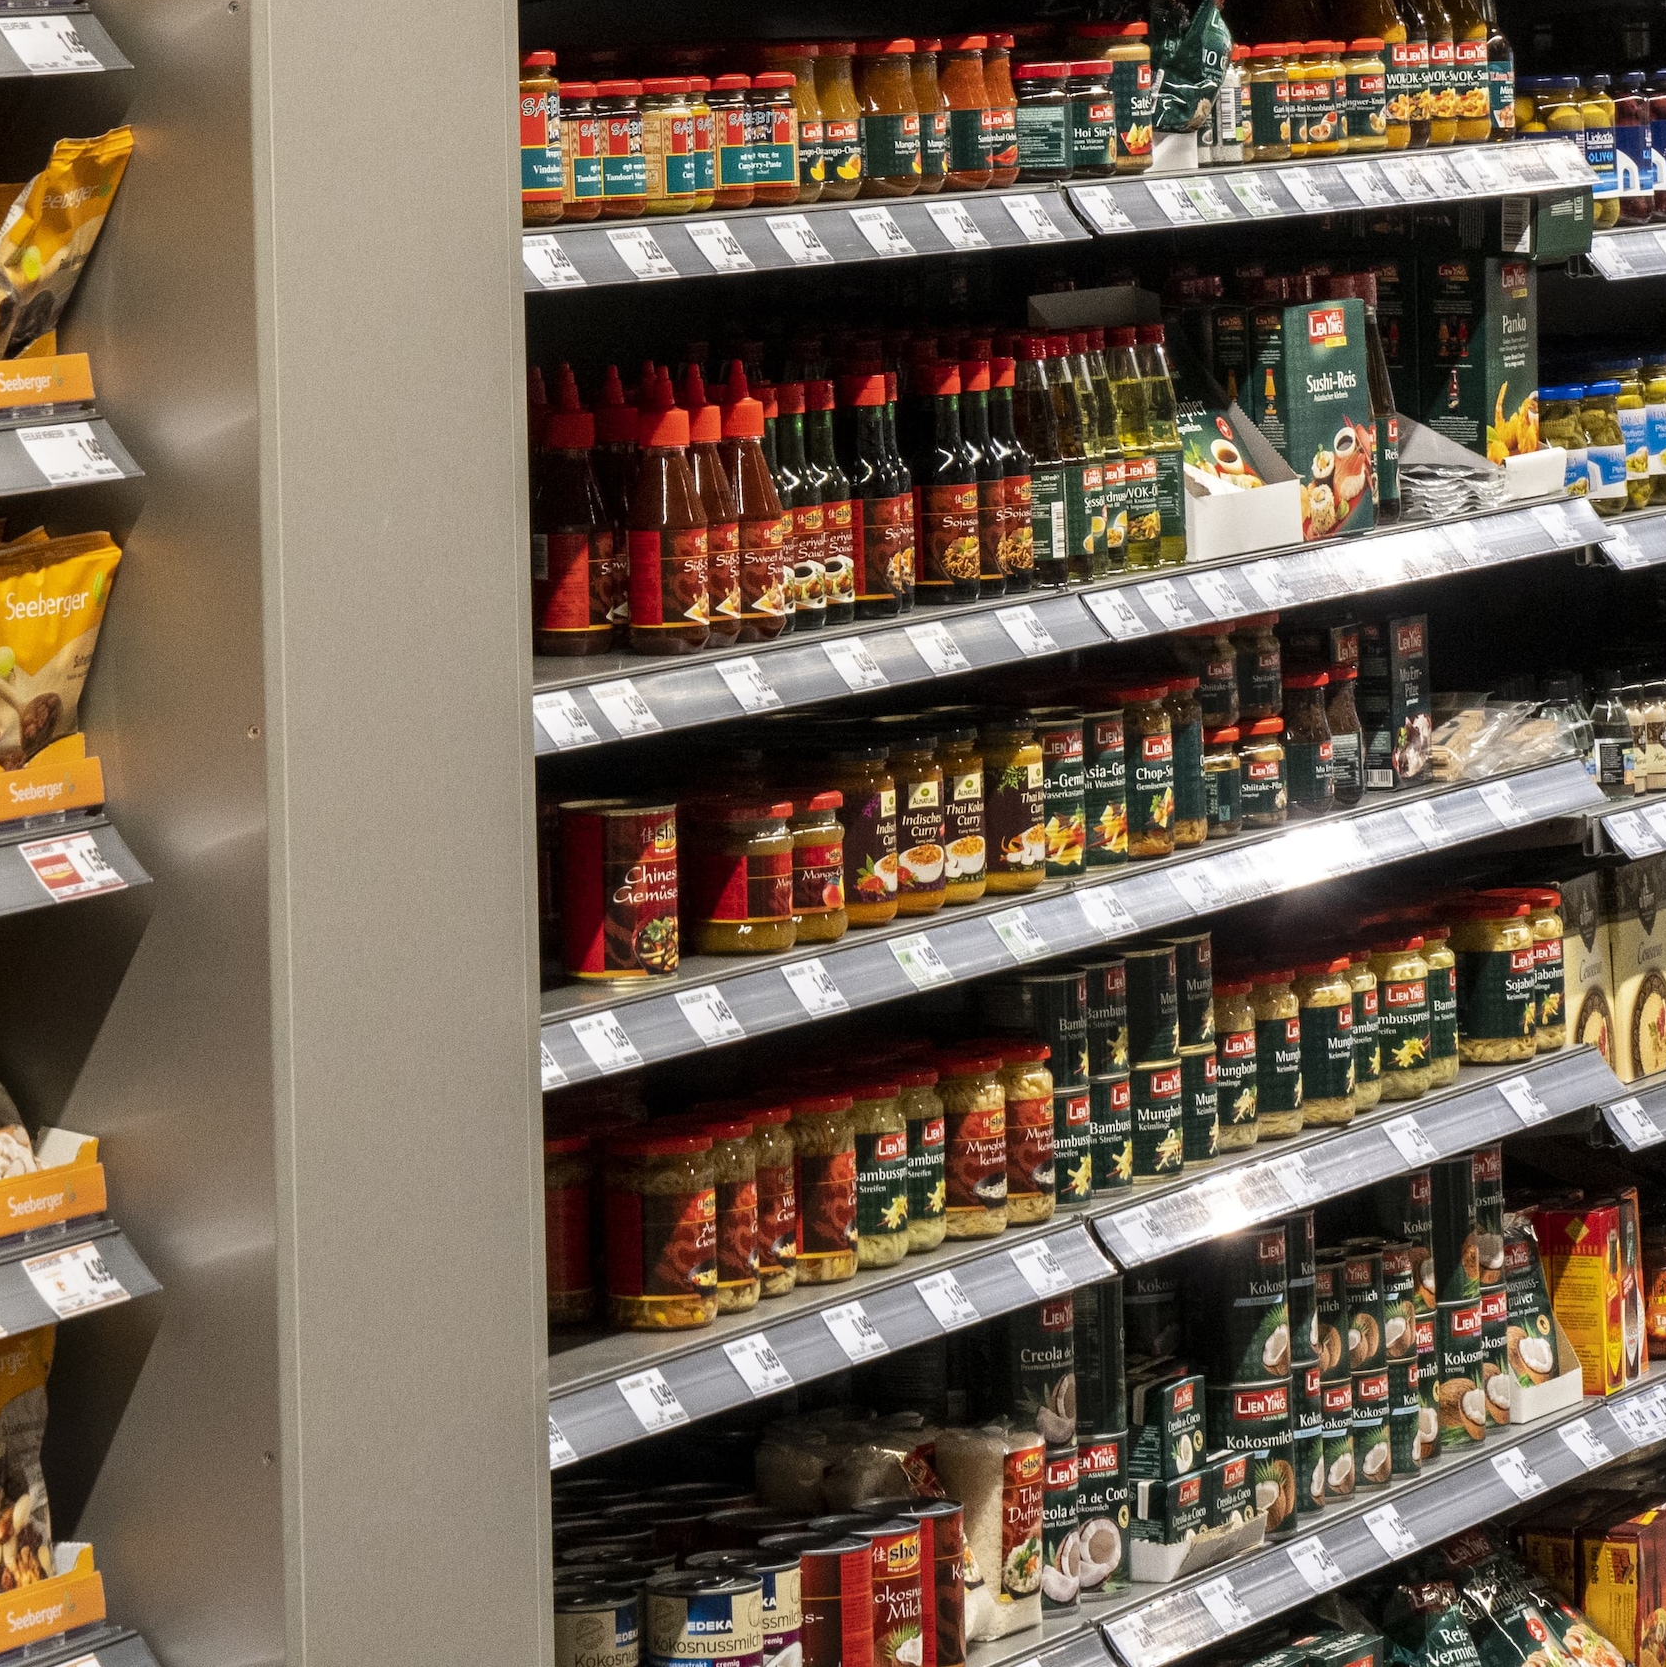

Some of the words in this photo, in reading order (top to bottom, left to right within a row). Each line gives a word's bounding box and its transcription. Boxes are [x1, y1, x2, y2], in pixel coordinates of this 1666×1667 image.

[1074, 128, 1091, 138] Hoi
[638, 241, 662, 259] 2.29
[717, 237, 742, 255] 2.29
[1310, 318, 1326, 336] LIEN
[1326, 313, 1343, 333] YING
[1503, 314, 1526, 333] Panko
[1307, 371, 1356, 393] Sushi-Reis
[5, 592, 89, 620] Seeberger
[10, 780, 63, 801] Seeberger
[903, 814, 942, 827] Indisches
[912, 825, 938, 838] Curry
[860, 1184, 886, 1193] Streifen
[7, 1192, 65, 1217] Seeberger
[1237, 1396, 1263, 1414] LIEN
[1263, 1390, 1286, 1411] YING
[1227, 1432, 1292, 1449] Kokosmilch
[1105, 1488, 1127, 1501] Coco
[6, 1606, 63, 1633] Seeberger
[687, 1619, 733, 1631] EDEKA
[653, 1635, 761, 1653] Kokosnussmilch
